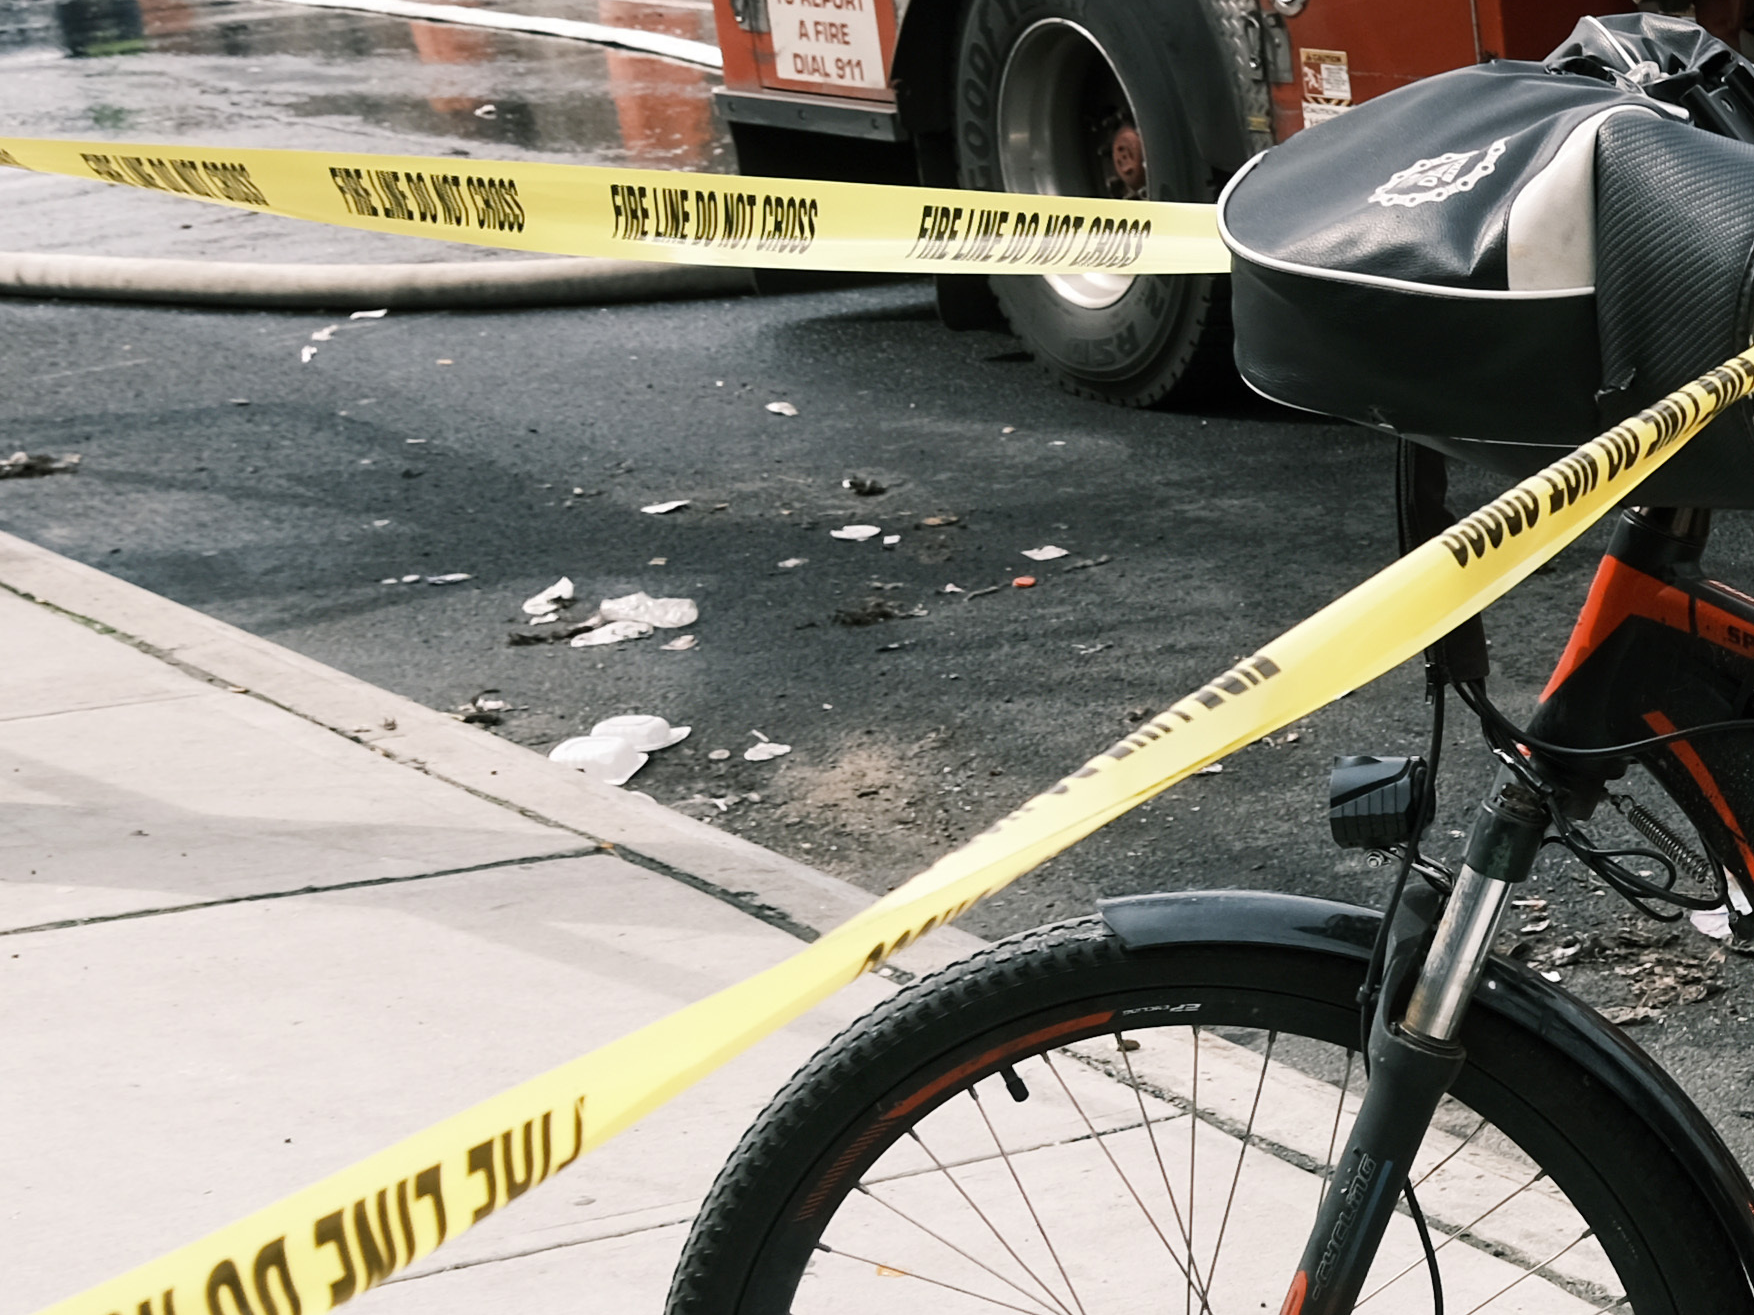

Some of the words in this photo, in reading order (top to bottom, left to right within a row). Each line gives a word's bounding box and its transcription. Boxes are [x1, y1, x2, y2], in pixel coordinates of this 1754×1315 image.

[798, 20, 810, 41] A
[814, 21, 851, 46] FIRE
[793, 53, 831, 79] DIAL
[835, 59, 865, 82] 911
[610, 184, 650, 240] FIRE
[650, 187, 690, 245] LINE
[690, 190, 719, 248] DO
[718, 192, 757, 250] NOT
[756, 195, 819, 254] CROSS
[905, 205, 964, 259] FIRE
[953, 208, 1010, 262] LINE
[996, 212, 1041, 265] DO
[1025, 214, 1086, 266] NOT
[1069, 217, 1152, 269] CROSS
